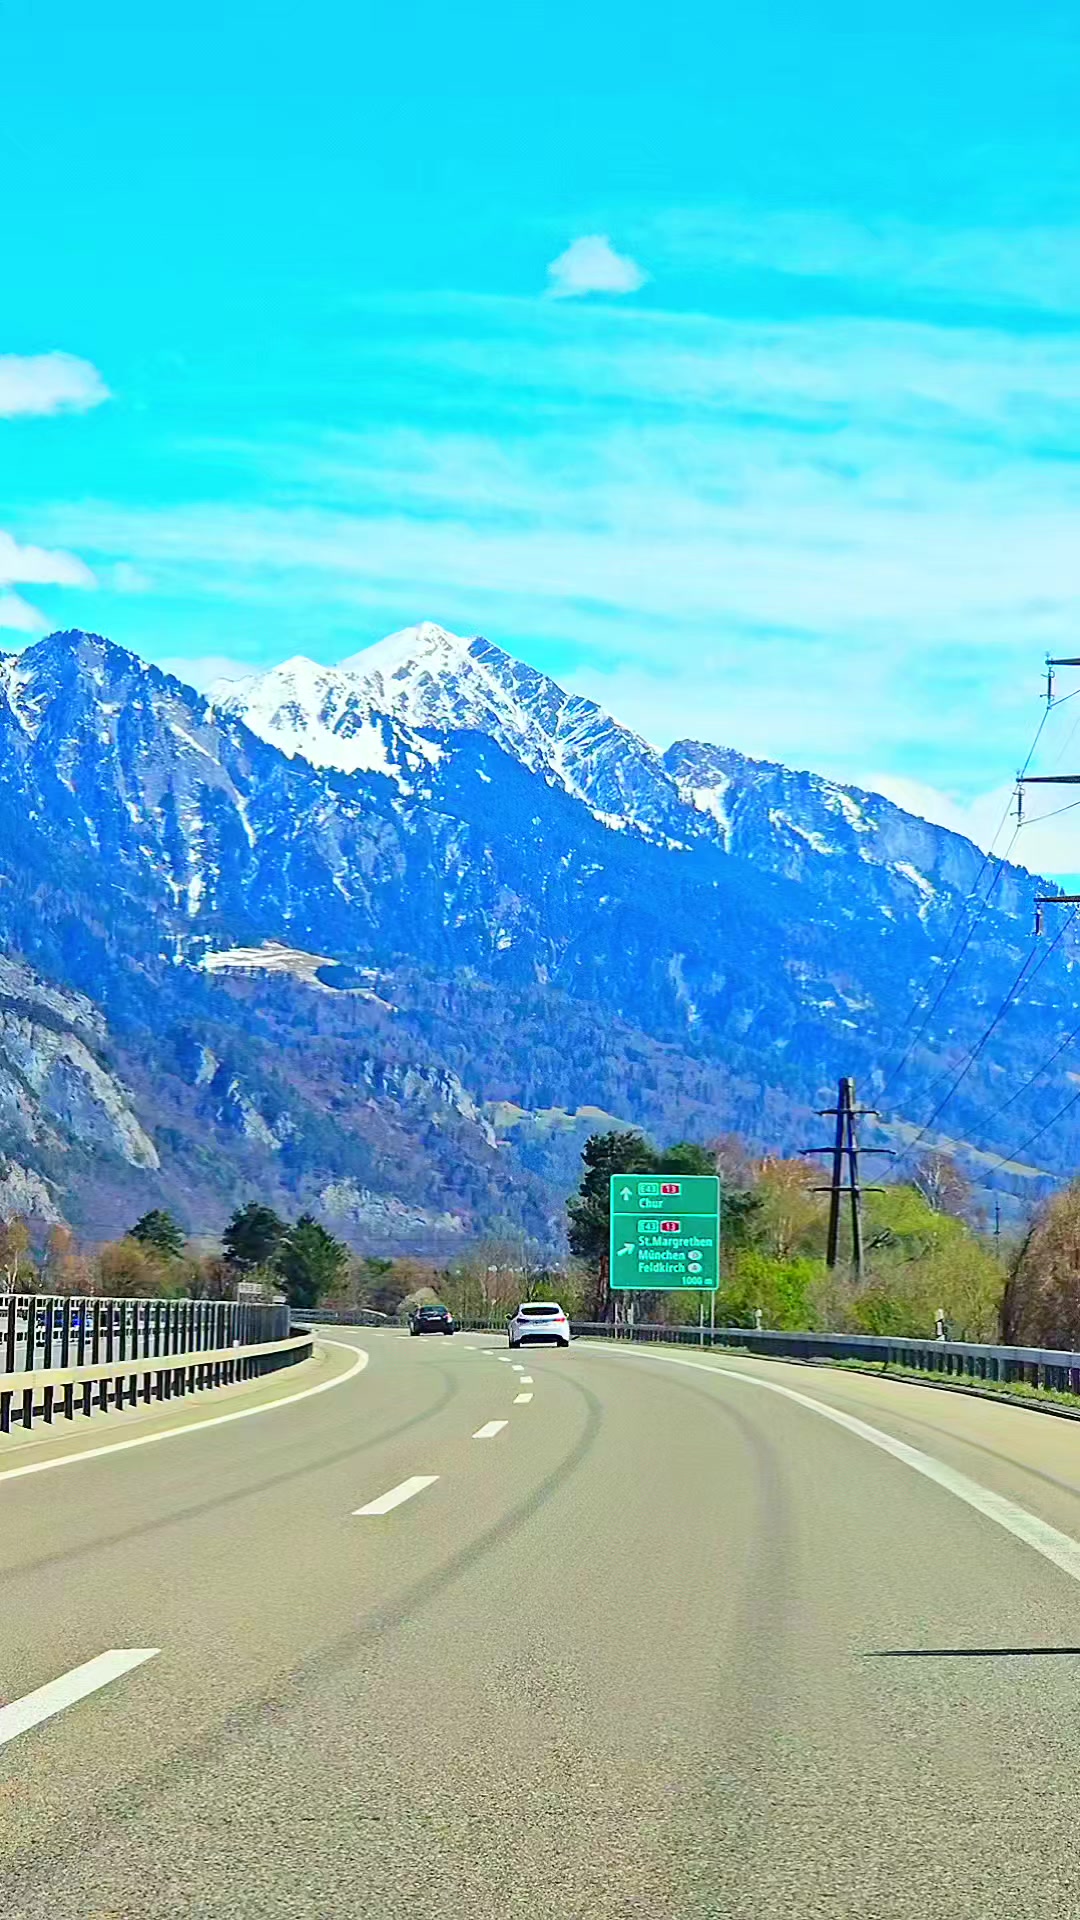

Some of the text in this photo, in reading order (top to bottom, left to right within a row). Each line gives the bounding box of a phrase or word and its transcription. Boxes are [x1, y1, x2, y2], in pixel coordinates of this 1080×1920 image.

[665, 1184, 677, 1194] 13
[639, 1198, 663, 1208] Chur
[666, 1222, 677, 1232] 13
[638, 1250, 686, 1260] München
[638, 1262, 686, 1273] Feldkirch
[682, 1277, 703, 1285] 1000
